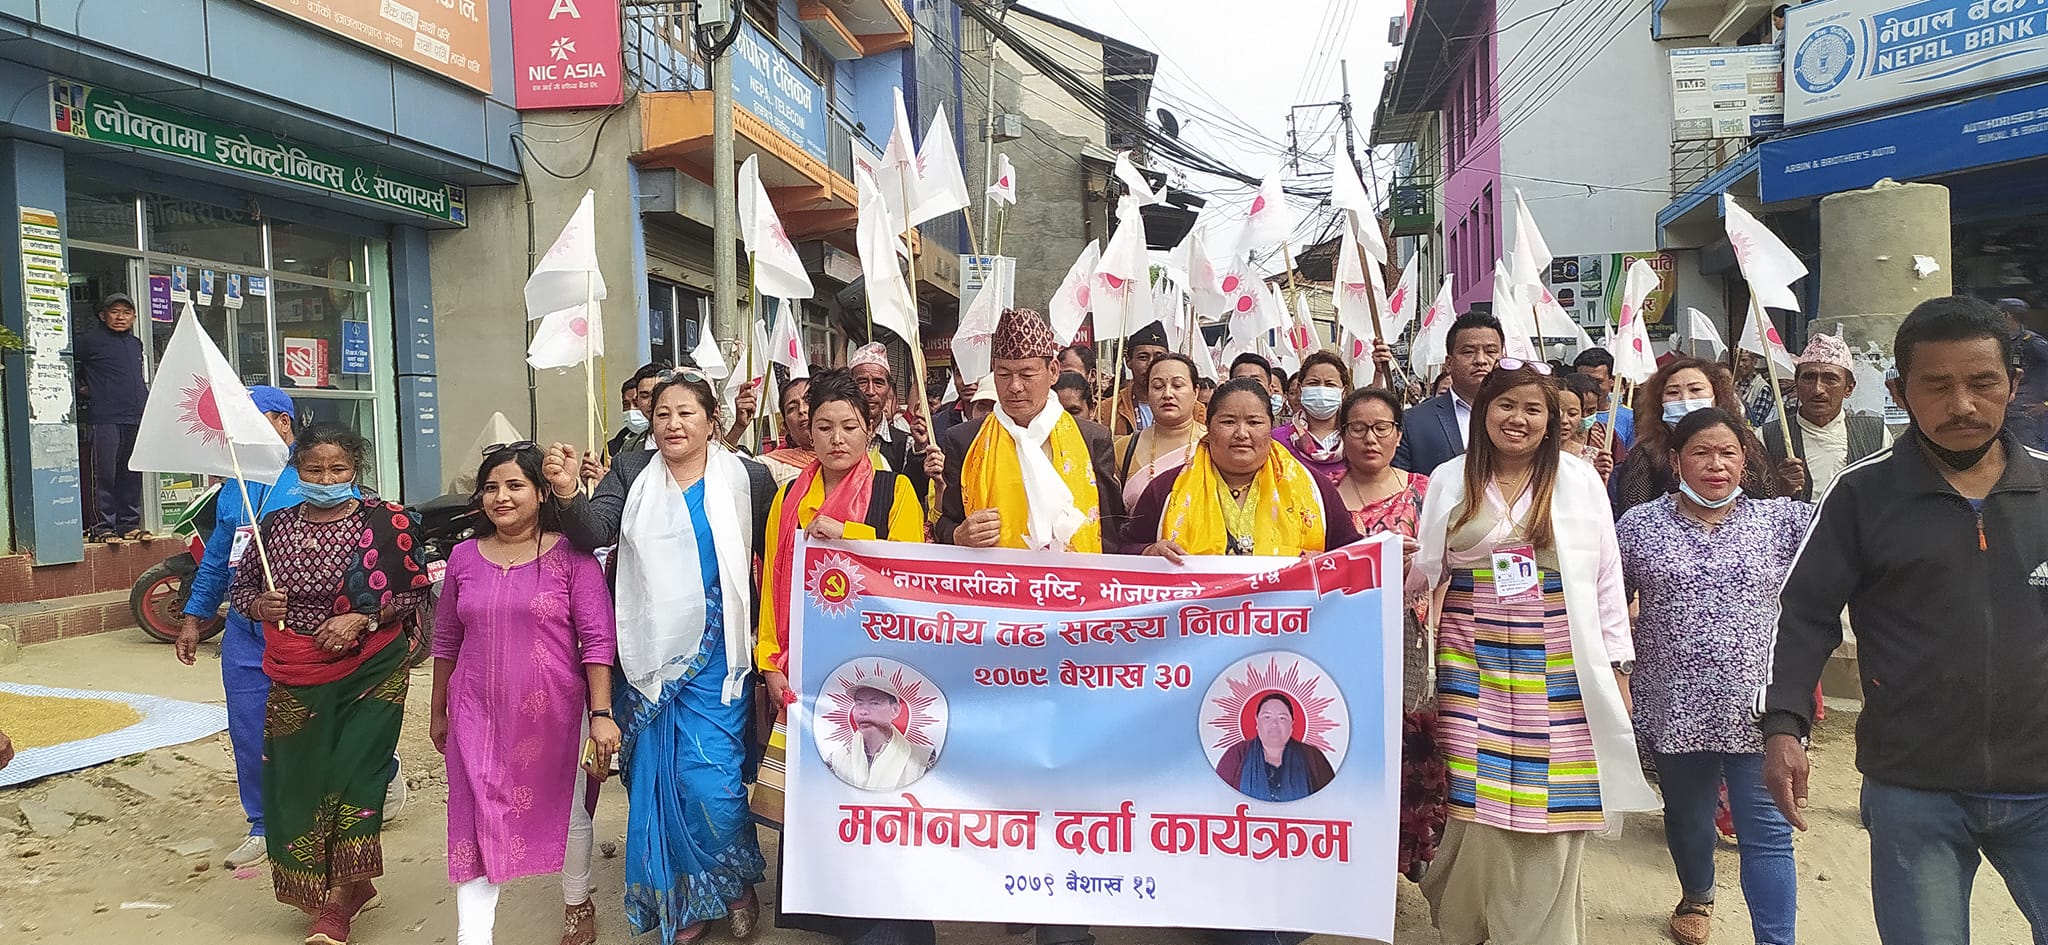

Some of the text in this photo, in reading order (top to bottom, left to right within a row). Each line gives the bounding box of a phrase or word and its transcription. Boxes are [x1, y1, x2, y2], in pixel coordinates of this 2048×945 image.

[1880, 8, 1957, 44] नेपाल
[1878, 39, 1953, 72] NEPAL
[1965, 17, 2035, 51] BANK
[528, 62, 606, 81] NIC ASIA
[749, 75, 774, 106] NEPAL
[774, 95, 805, 130] TELECOM
[1961, 112, 2034, 135] AUTHORISED
[93, 100, 446, 213] लोक्तामा इलेक्ट्रोनिक्स् & सप्लायर्स
[1820, 151, 1870, 169] BROTHER'S
[1871, 145, 1897, 158] AUTO
[161, 490, 177, 500] AYA
[1029, 573, 1086, 606] दृष्टि,
[862, 600, 1313, 648] स्थानीय तह सदस्य निर्वाचन
[974, 658, 1192, 690] २०७९ बैशाख ३०
[838, 792, 1353, 864] मनोनयन दर्ता कार्यक्रम
[1004, 869, 1156, 900] २०७९ बैशाख १२
